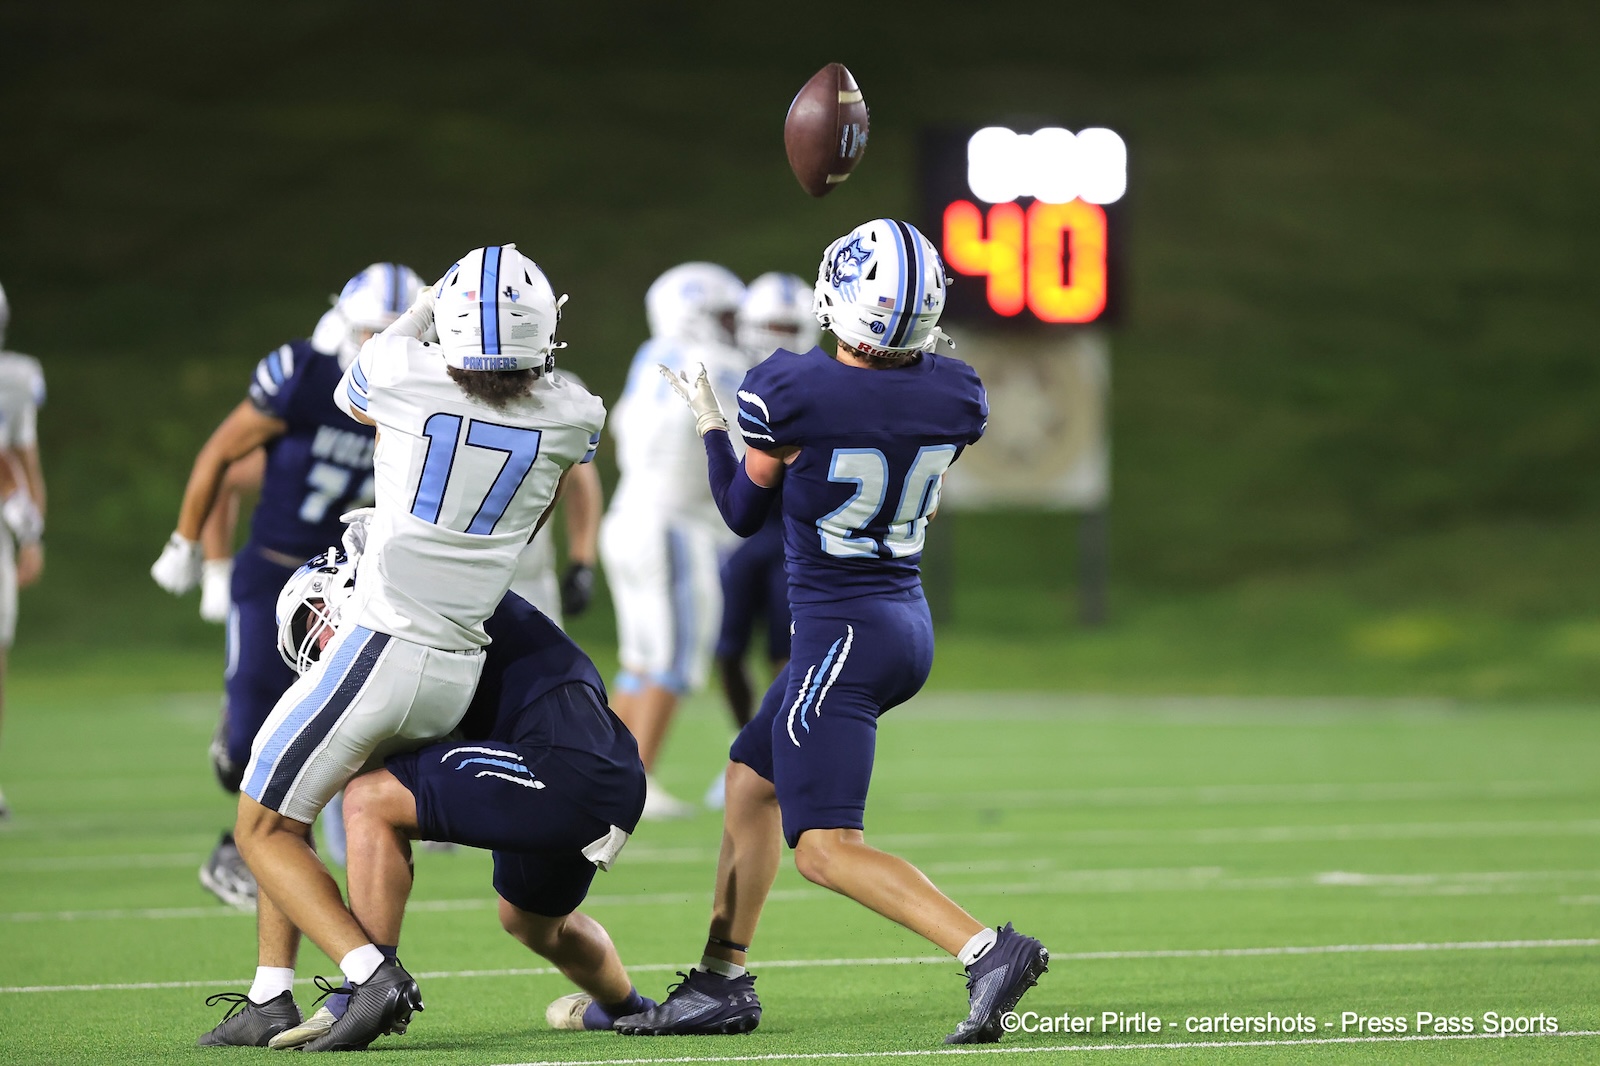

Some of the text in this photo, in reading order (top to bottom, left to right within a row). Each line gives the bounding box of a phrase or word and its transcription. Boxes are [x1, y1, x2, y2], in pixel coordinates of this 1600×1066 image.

[943, 199, 1107, 323] 40
[463, 356, 518, 370] PANTHERS
[871, 321, 883, 333] 20
[410, 412, 542, 535] 17
[815, 443, 957, 559] 20
